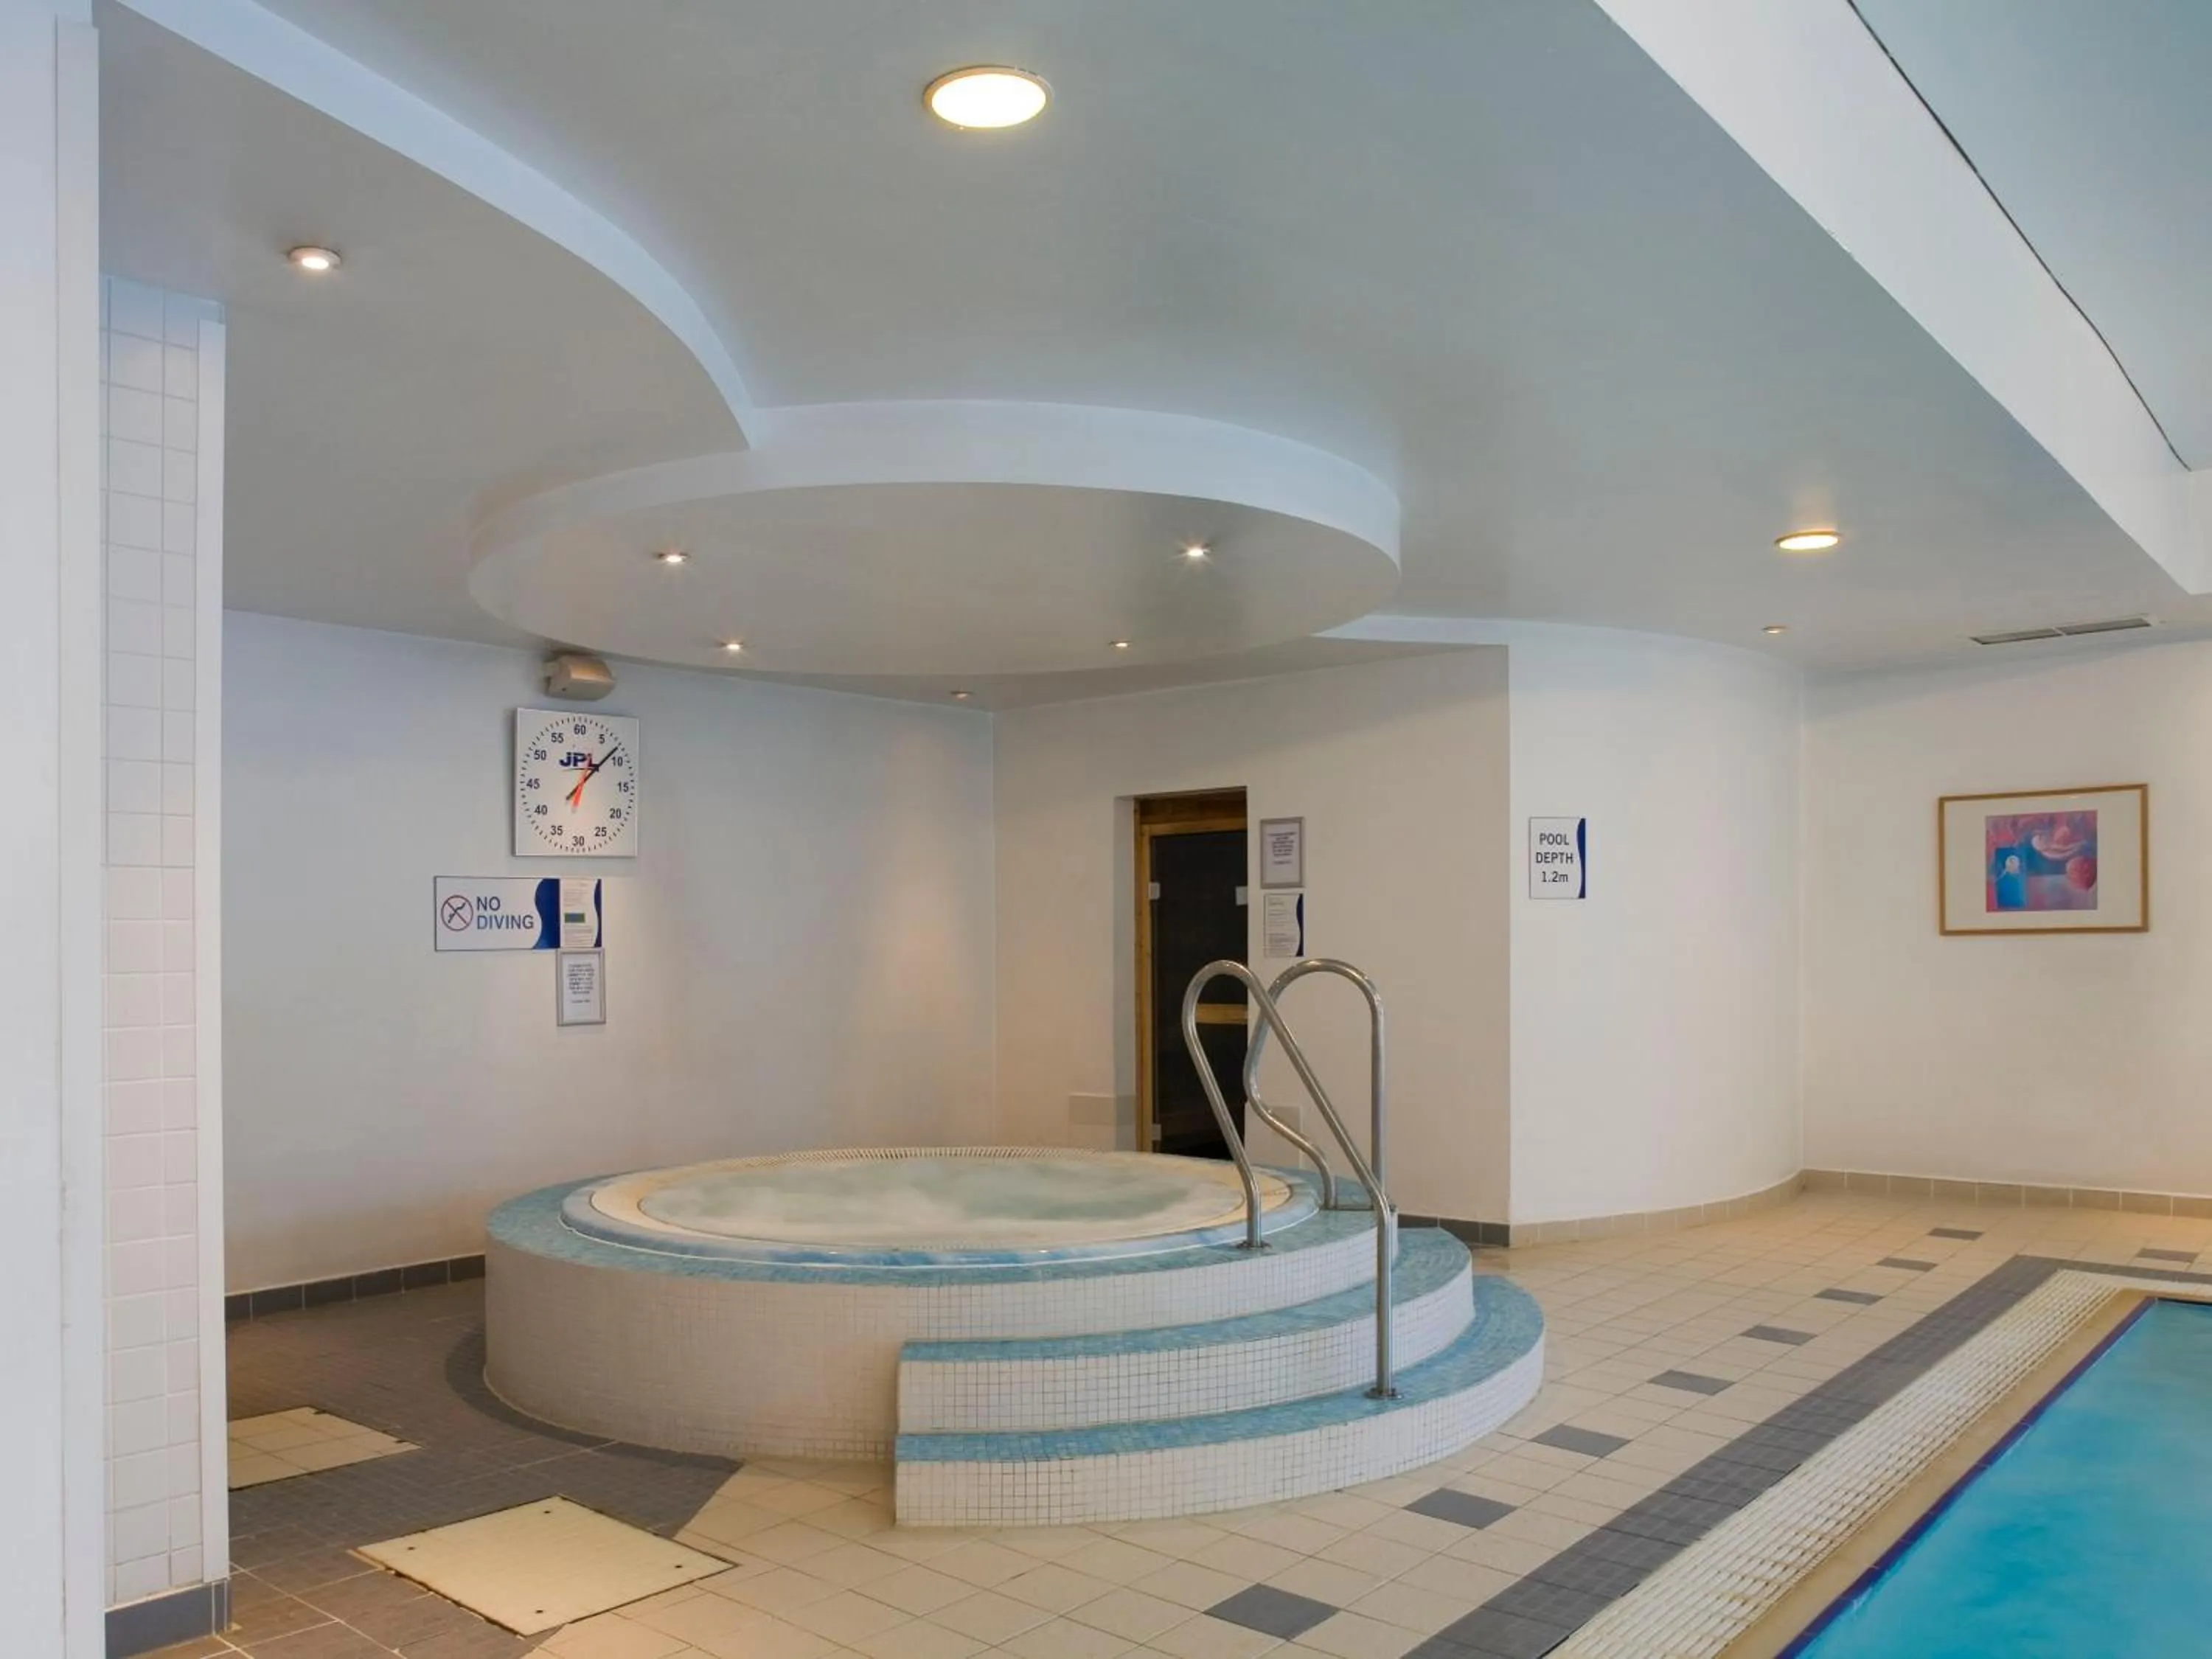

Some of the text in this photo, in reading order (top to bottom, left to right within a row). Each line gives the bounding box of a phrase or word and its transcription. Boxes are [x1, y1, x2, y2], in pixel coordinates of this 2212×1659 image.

[574, 724, 586, 735] 60
[551, 733, 564, 743] 55
[599, 734, 605, 744] 5
[534, 750, 546, 760] 50
[559, 752, 599, 767] JPL
[612, 757, 623, 767] 10
[526, 779, 540, 789] 45
[618, 782, 629, 792] 15
[534, 805, 548, 815] 40
[610, 808, 622, 818] 20
[551, 825, 563, 835] 35
[595, 827, 607, 837] 25
[572, 836, 585, 846] 30
[1539, 832, 1569, 845] POOL
[1535, 852, 1573, 863] DEPTH
[1542, 871, 1568, 883] 1.2m
[476, 896, 501, 911] NO
[476, 914, 534, 930] DIVING
